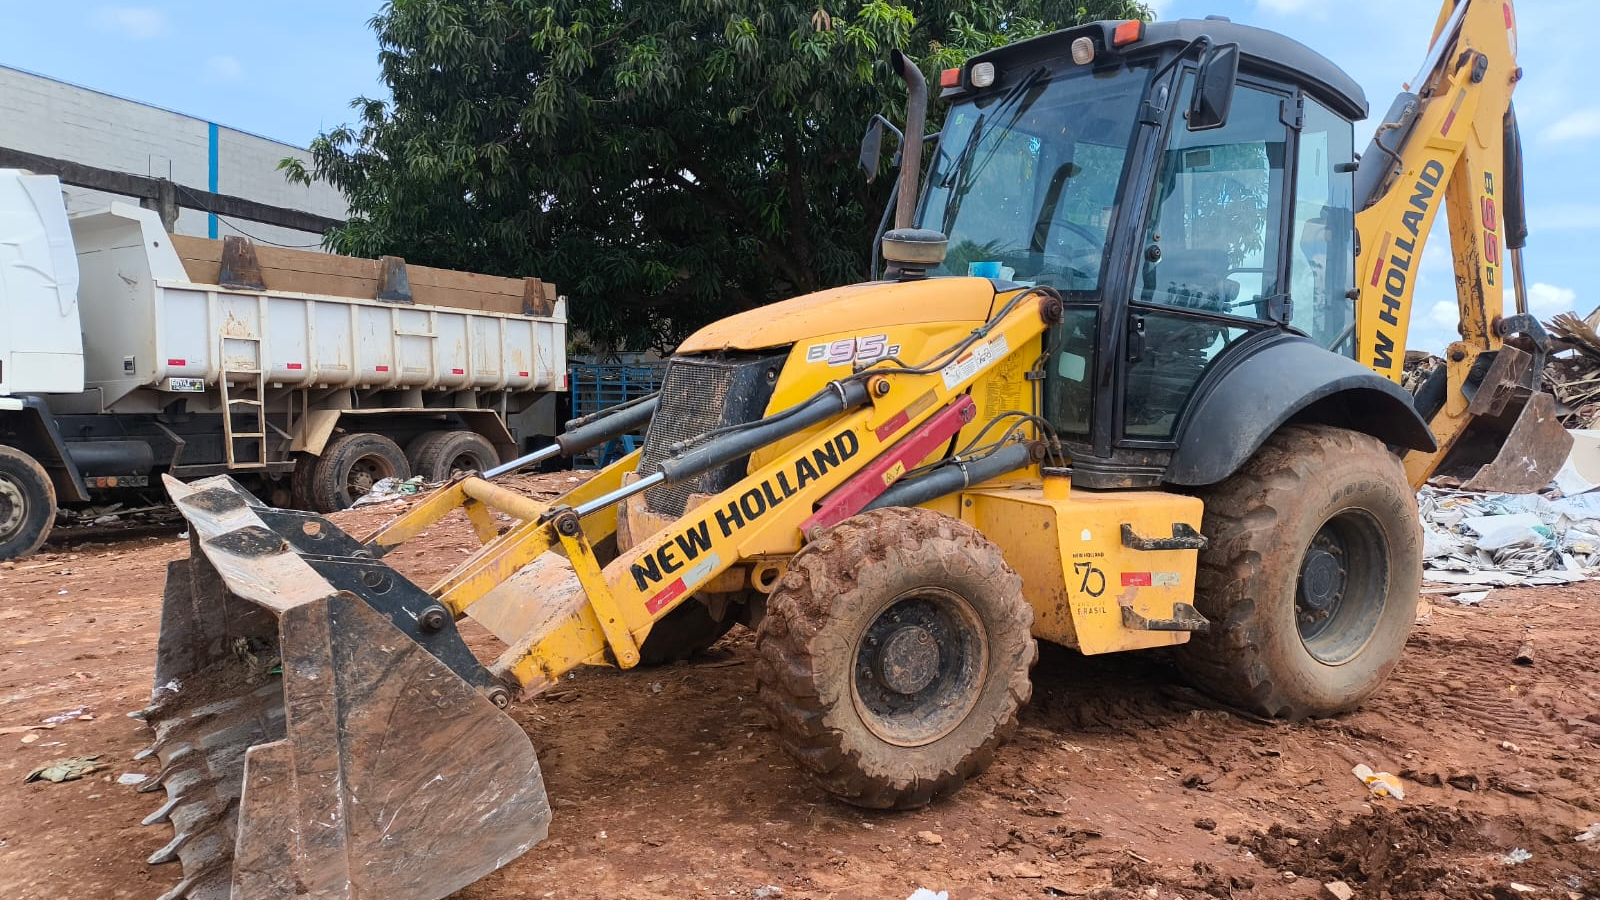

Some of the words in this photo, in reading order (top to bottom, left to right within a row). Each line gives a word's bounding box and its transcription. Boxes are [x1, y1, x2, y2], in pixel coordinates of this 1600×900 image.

[1379, 159, 1444, 326] HOLLAND
[630, 518, 712, 592] NEW
[714, 429, 860, 538] HOLLAND
[1074, 562, 1105, 597] 70
